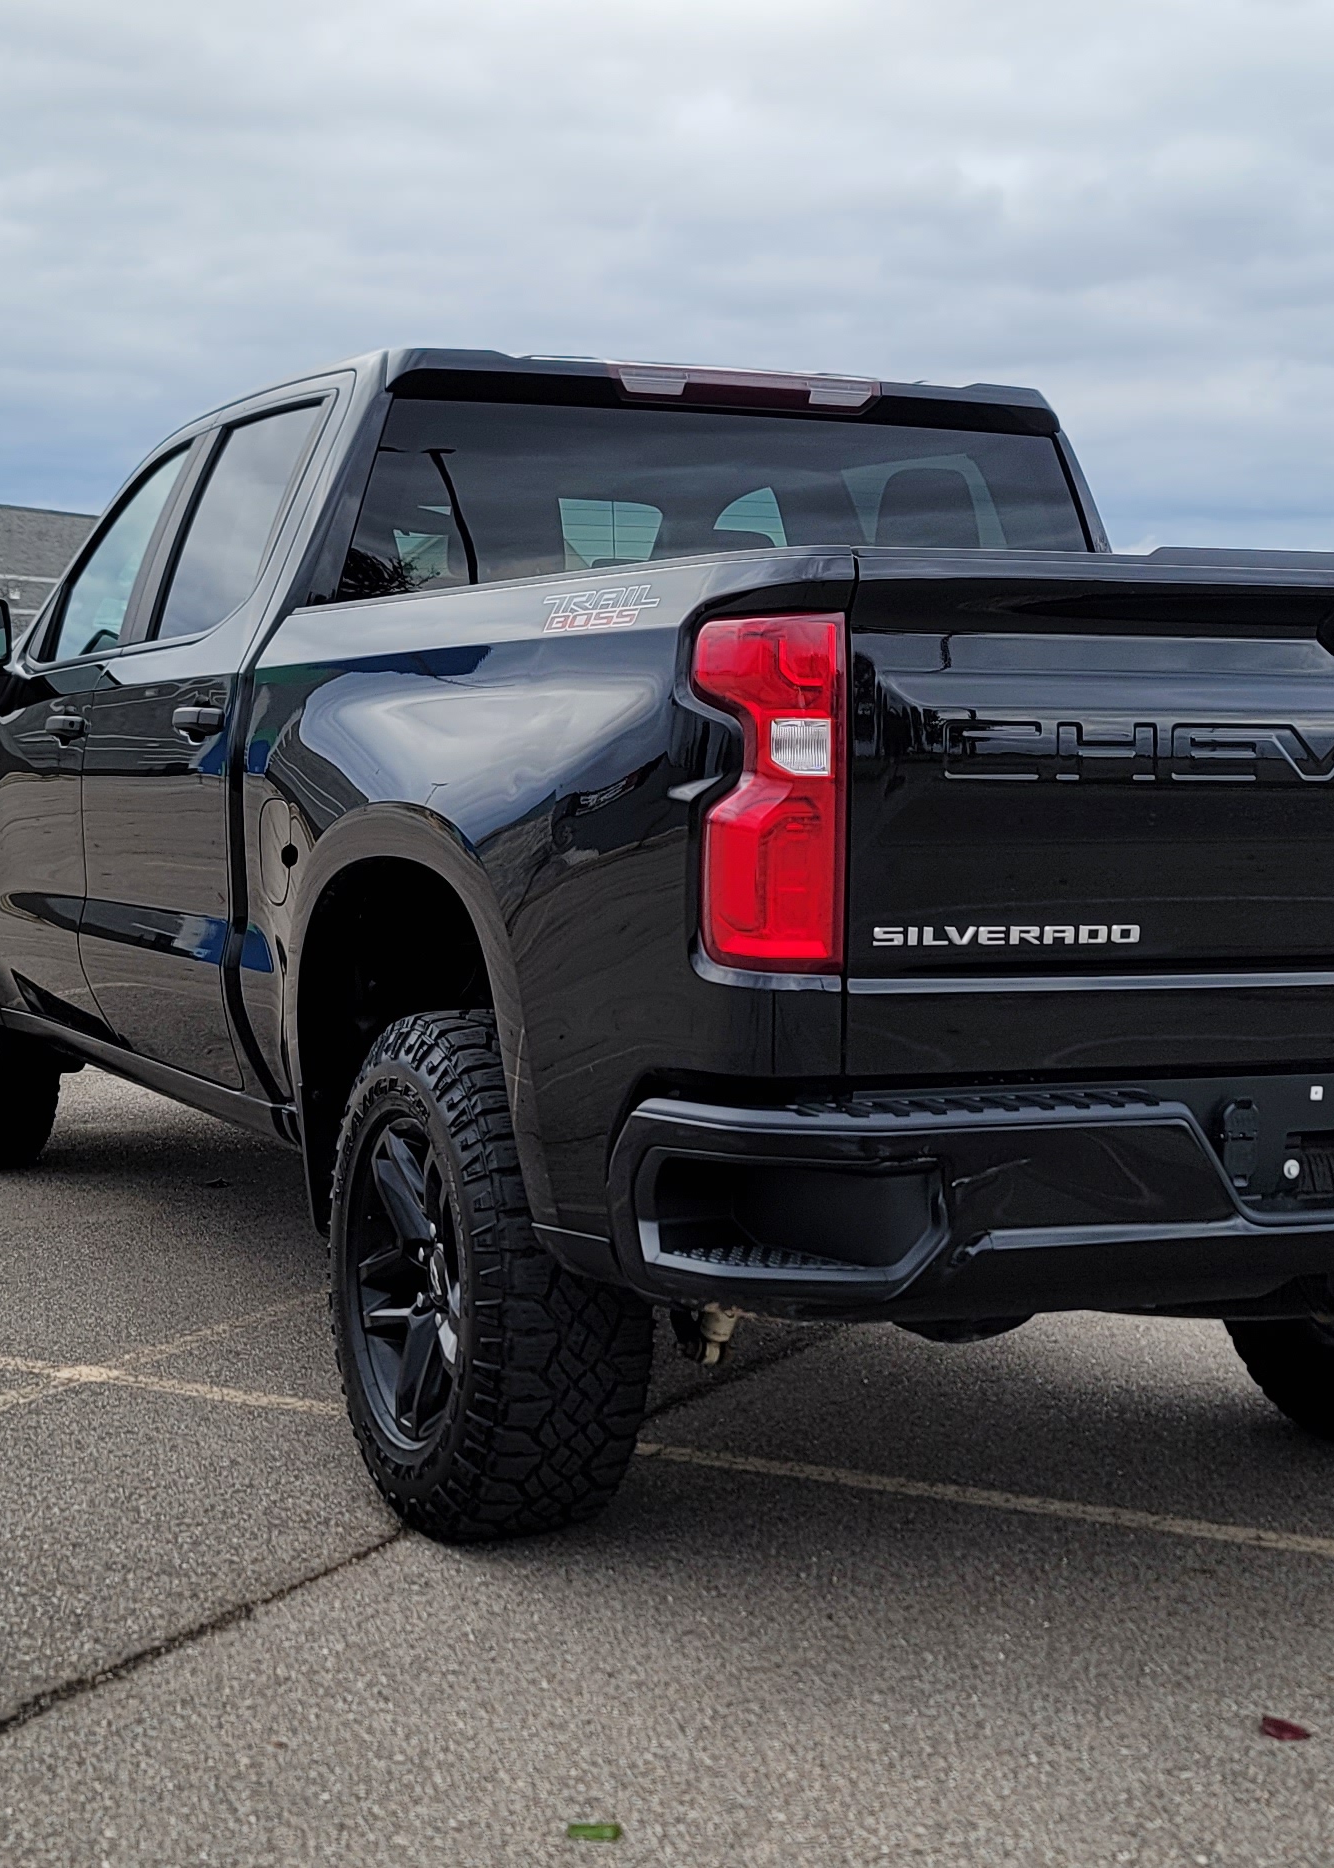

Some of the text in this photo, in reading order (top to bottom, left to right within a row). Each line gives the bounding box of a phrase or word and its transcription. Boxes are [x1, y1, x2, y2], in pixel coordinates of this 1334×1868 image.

[543, 584, 660, 613] TRAIL
[543, 608, 641, 633] BOSS
[872, 924, 1141, 946] SILVERADO
